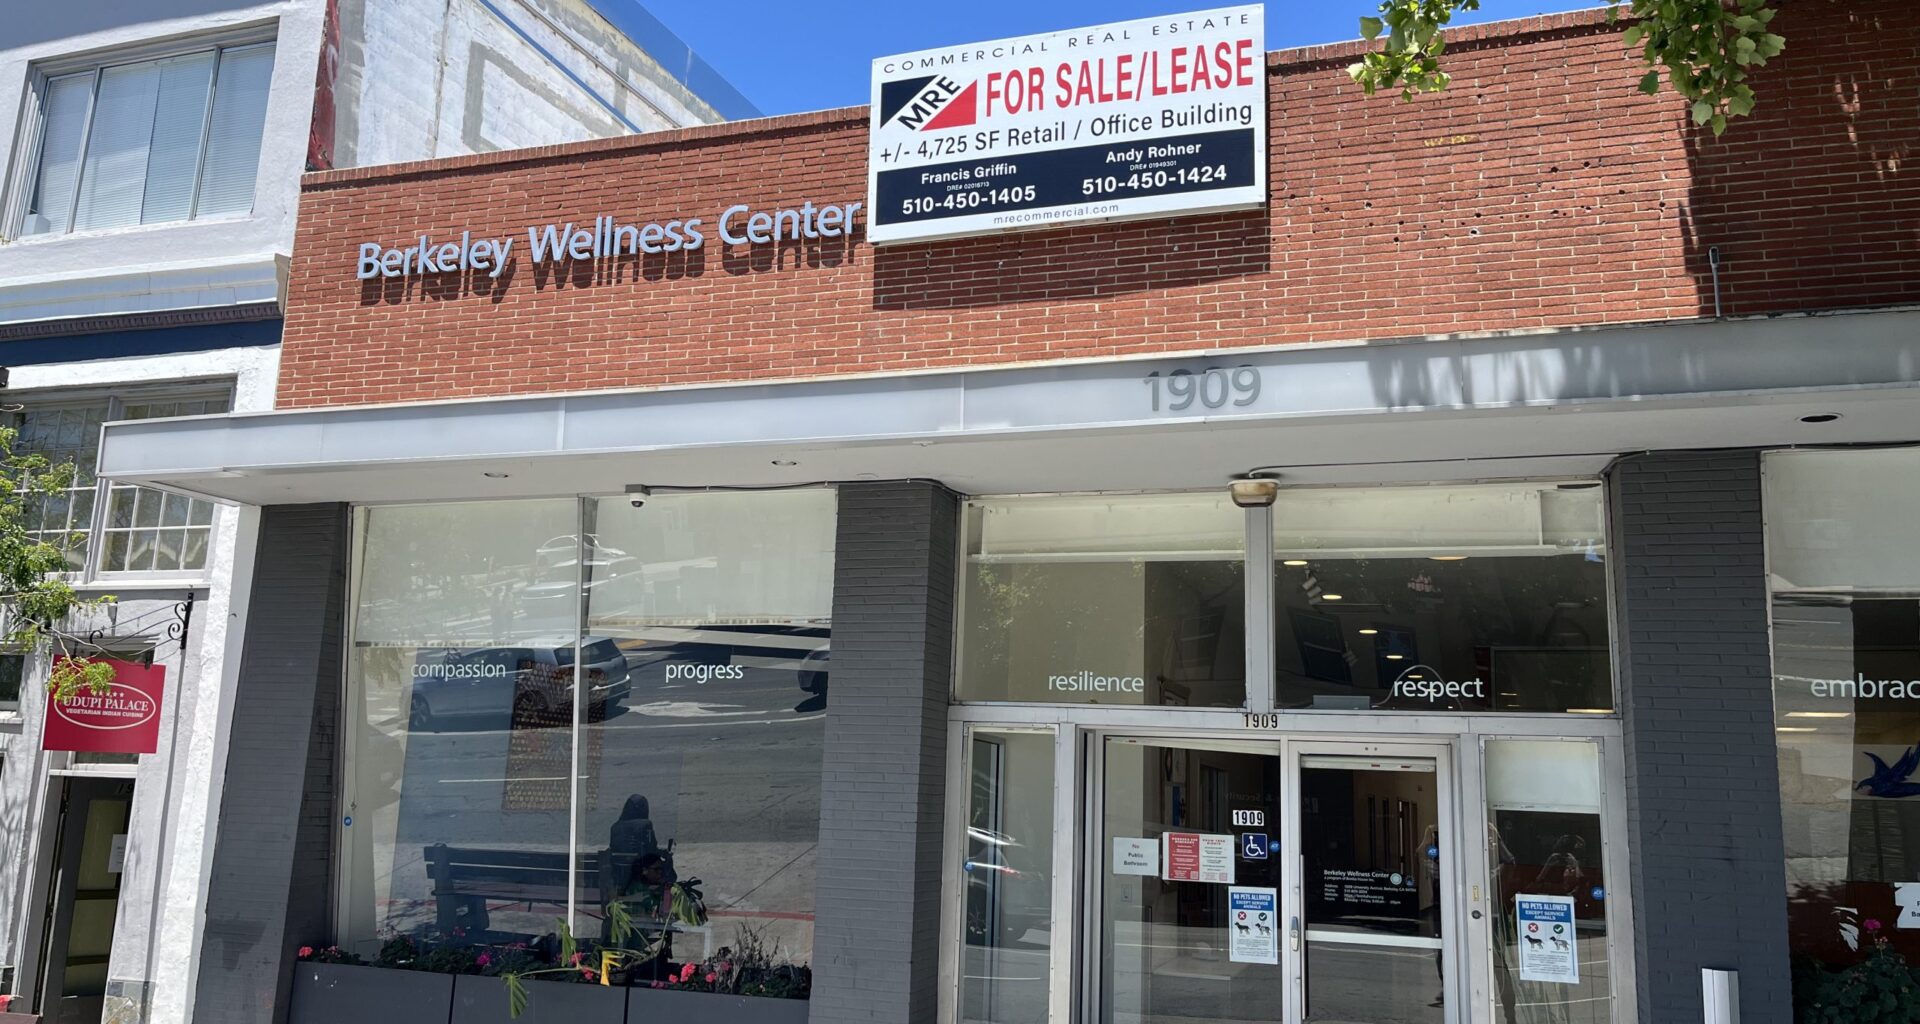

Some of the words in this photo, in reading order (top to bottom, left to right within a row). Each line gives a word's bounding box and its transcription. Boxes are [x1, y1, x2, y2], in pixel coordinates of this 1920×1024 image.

[884, 42, 1047, 73] COMMERCIAL
[1069, 30, 1130, 48] REAL
[1152, 14, 1248, 36] ESTATE
[986, 66, 1044, 117] FOR
[1055, 39, 1254, 108] SALE/LEASE
[897, 76, 961, 131] MRE
[880, 143, 910, 163] +/-
[917, 135, 967, 159] 4,725
[975, 130, 1000, 151] SF
[1008, 121, 1065, 147] Retail
[1074, 120, 1082, 140] /
[1091, 113, 1152, 137] Office
[1162, 102, 1252, 128] Building
[1105, 149, 1143, 165] Andy
[1148, 144, 1202, 159] Rohner
[921, 168, 970, 185] Francis
[974, 163, 1017, 178] Griffin
[1082, 165, 1227, 195] 510-450-1424
[902, 185, 1036, 215] 510-450-1405
[993, 203, 1119, 224] mrecommercial.com
[356, 230, 514, 280] Berkeley
[528, 215, 704, 263] Wellness
[718, 201, 863, 246] Center
[1143, 364, 1262, 411] 1909
[410, 659, 506, 685] compassion
[665, 661, 744, 684] progress
[1048, 671, 1145, 692] resilience
[1393, 677, 1485, 702] respect
[1810, 672, 1920, 699] embrac
[63, 695, 102, 709] UDUPI
[105, 698, 148, 712] PALACE
[66, 708, 101, 716] VEGETARIAN
[1244, 713, 1278, 728] 1909
[1234, 810, 1263, 825] 1909
[1323, 869, 1346, 877] Berkeley
[1347, 870, 1370, 878] Wellness
[1544, 903, 1567, 911] ALLOWED
